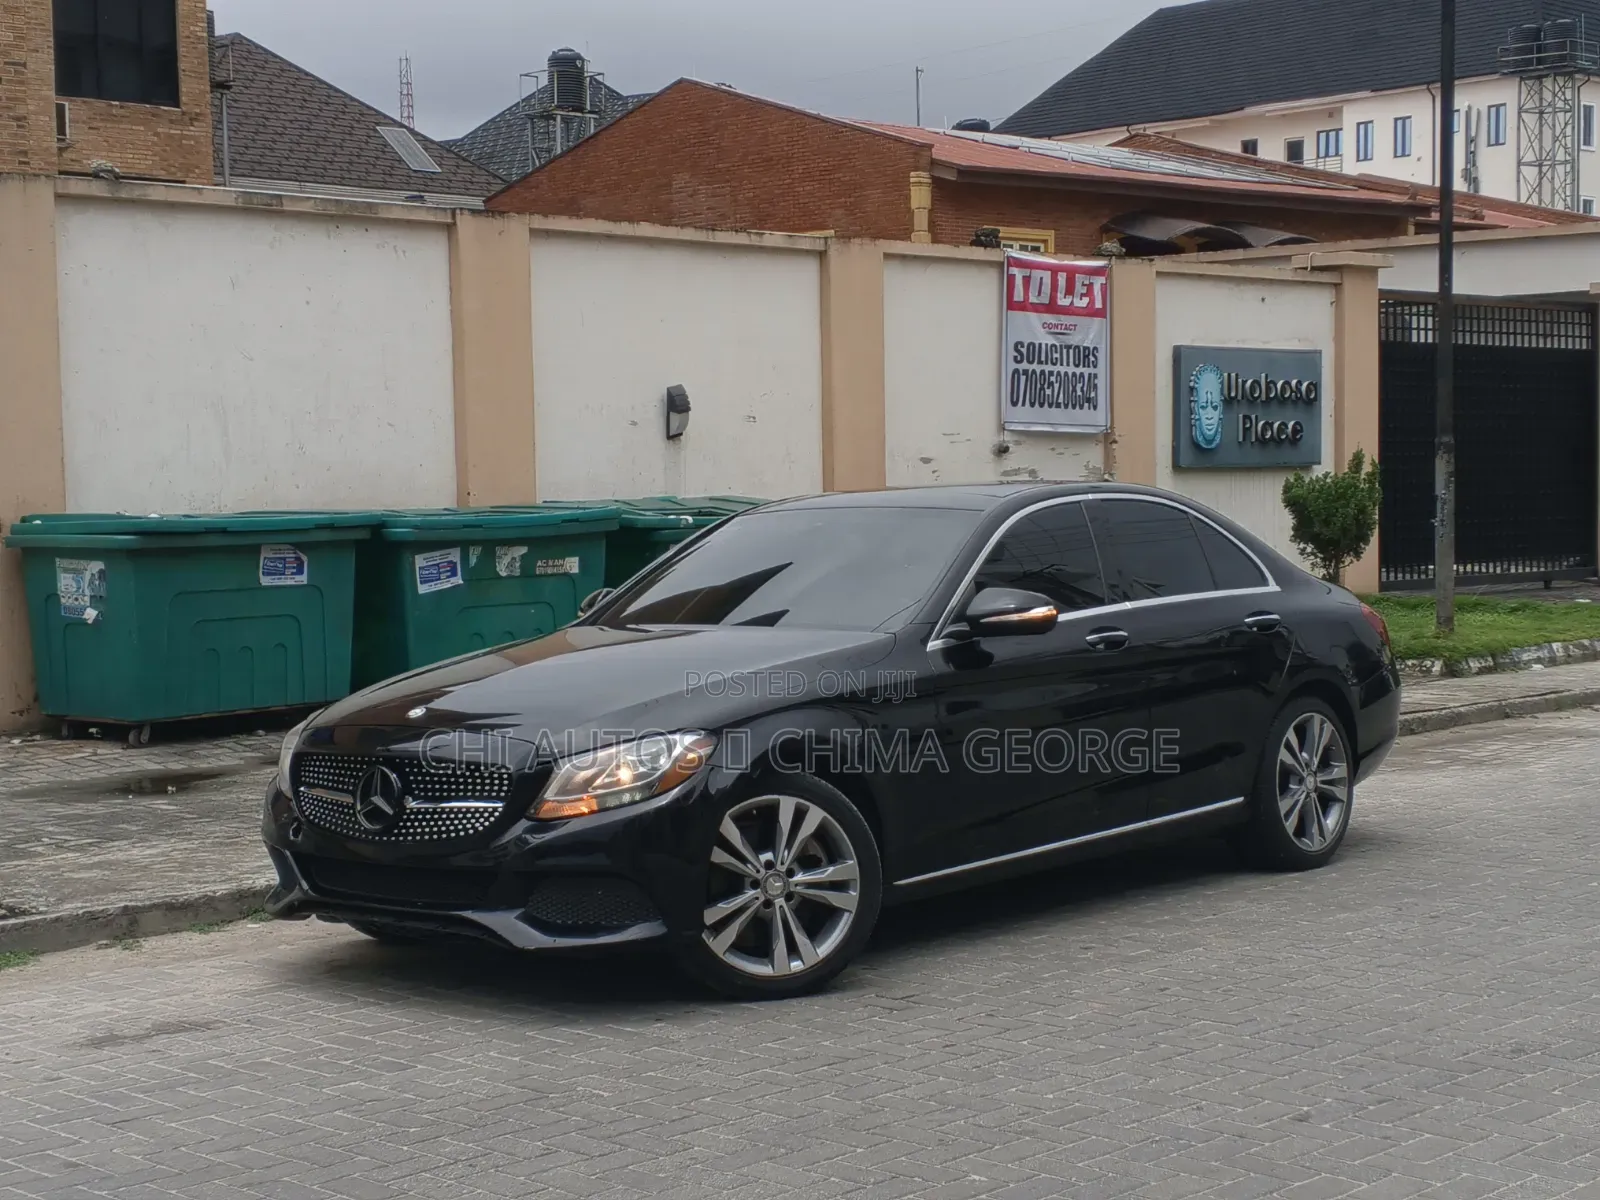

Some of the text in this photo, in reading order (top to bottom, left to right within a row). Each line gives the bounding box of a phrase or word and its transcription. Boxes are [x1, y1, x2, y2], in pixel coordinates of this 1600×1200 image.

[1008, 267, 1106, 309] TO LET
[1042, 321, 1078, 332] CONTACT
[1013, 340, 1099, 369] SOLICITORS
[1010, 368, 1098, 411] 07085208345
[1238, 413, 1304, 443] Place
